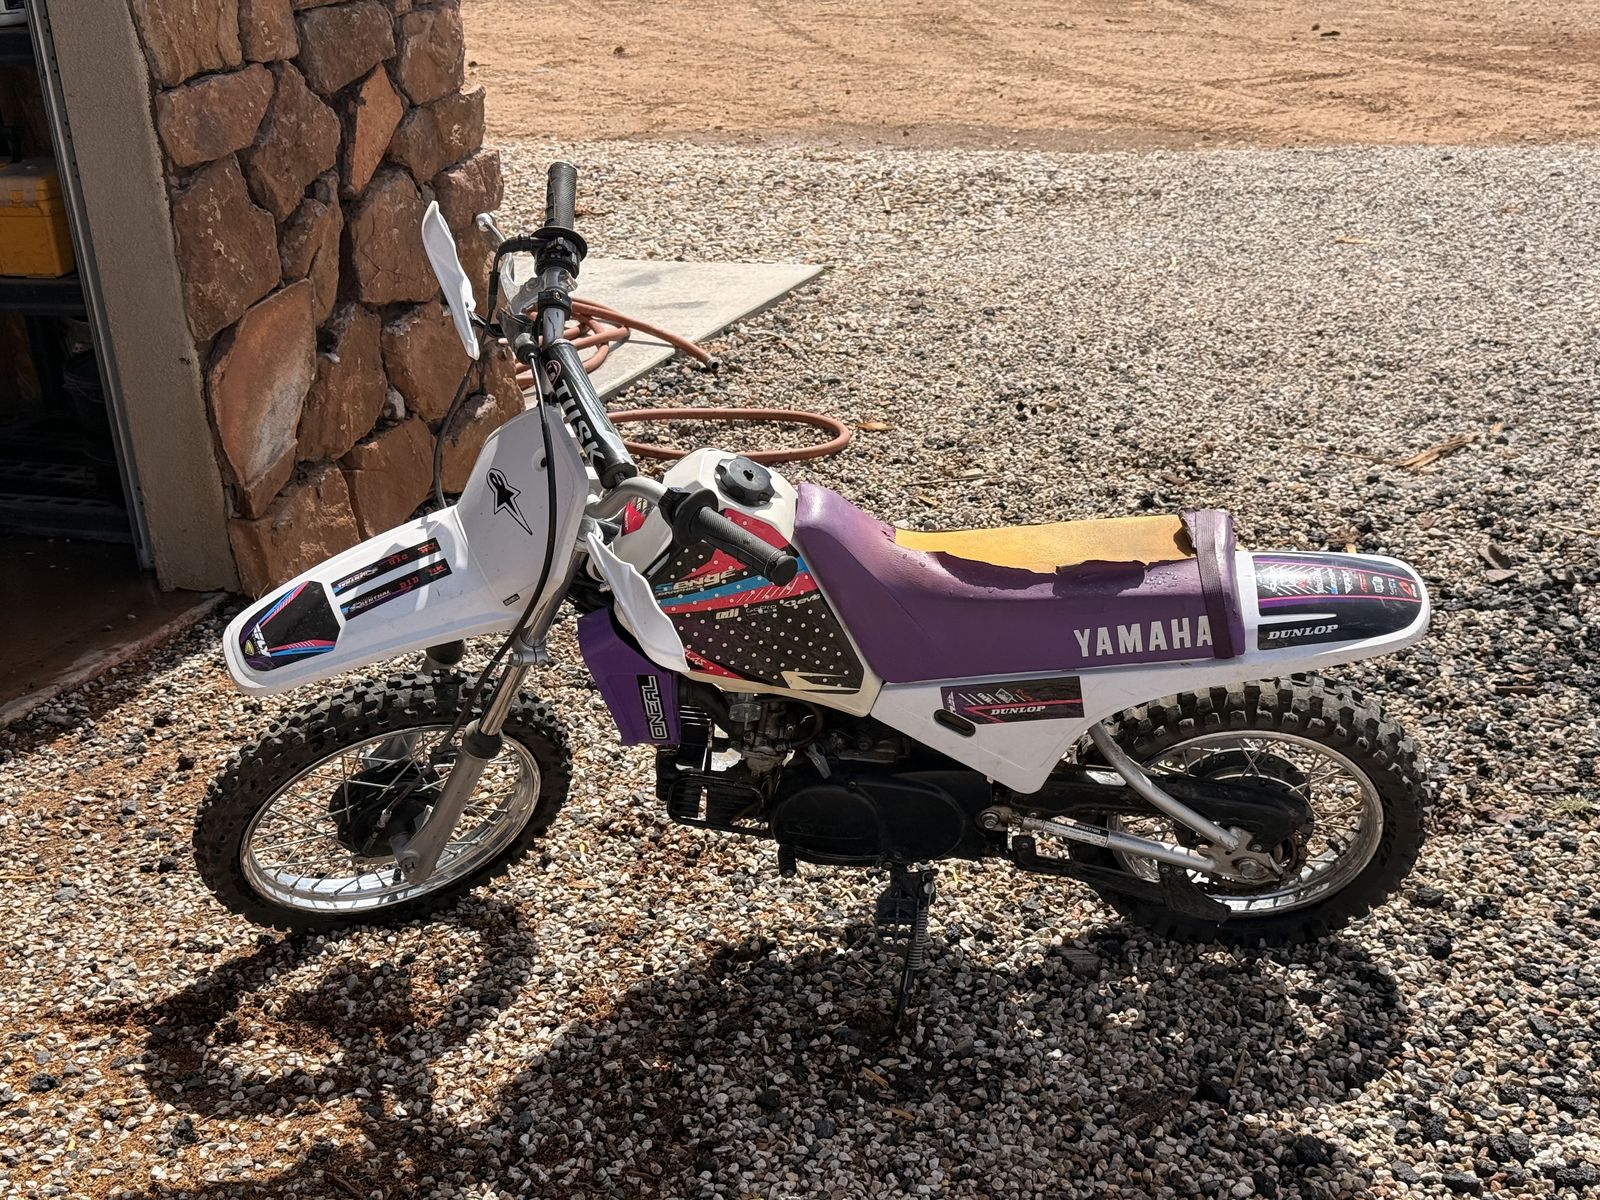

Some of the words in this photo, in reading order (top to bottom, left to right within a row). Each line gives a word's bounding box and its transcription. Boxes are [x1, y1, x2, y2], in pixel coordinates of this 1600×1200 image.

[555, 378, 606, 462] TUSK
[1073, 615, 1213, 657] YAMAHA
[1267, 624, 1339, 640] DUNLOP
[641, 675, 668, 740] ONEAL
[990, 705, 1046, 716] DUNLOP
